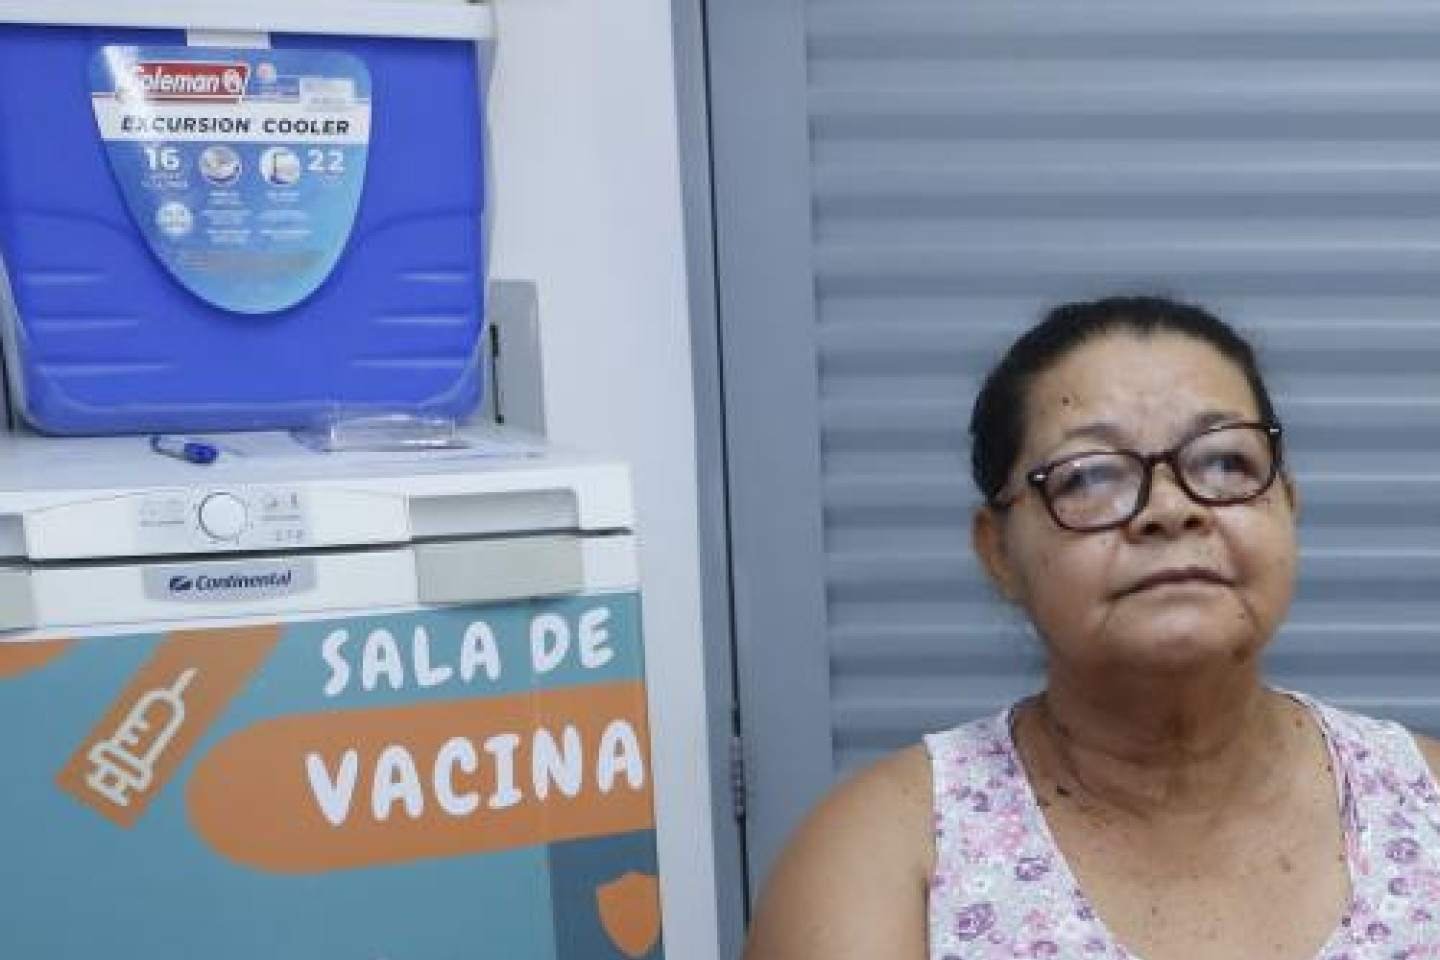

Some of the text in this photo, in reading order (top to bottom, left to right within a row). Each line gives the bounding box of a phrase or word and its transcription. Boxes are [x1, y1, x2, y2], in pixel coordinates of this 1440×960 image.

[262, 119, 350, 135] COOLER
[147, 148, 180, 171] 16
[307, 149, 345, 171] 22
[195, 570, 292, 591] Continental
[321, 606, 614, 697] SALA DE
[304, 719, 646, 825] VACINA
